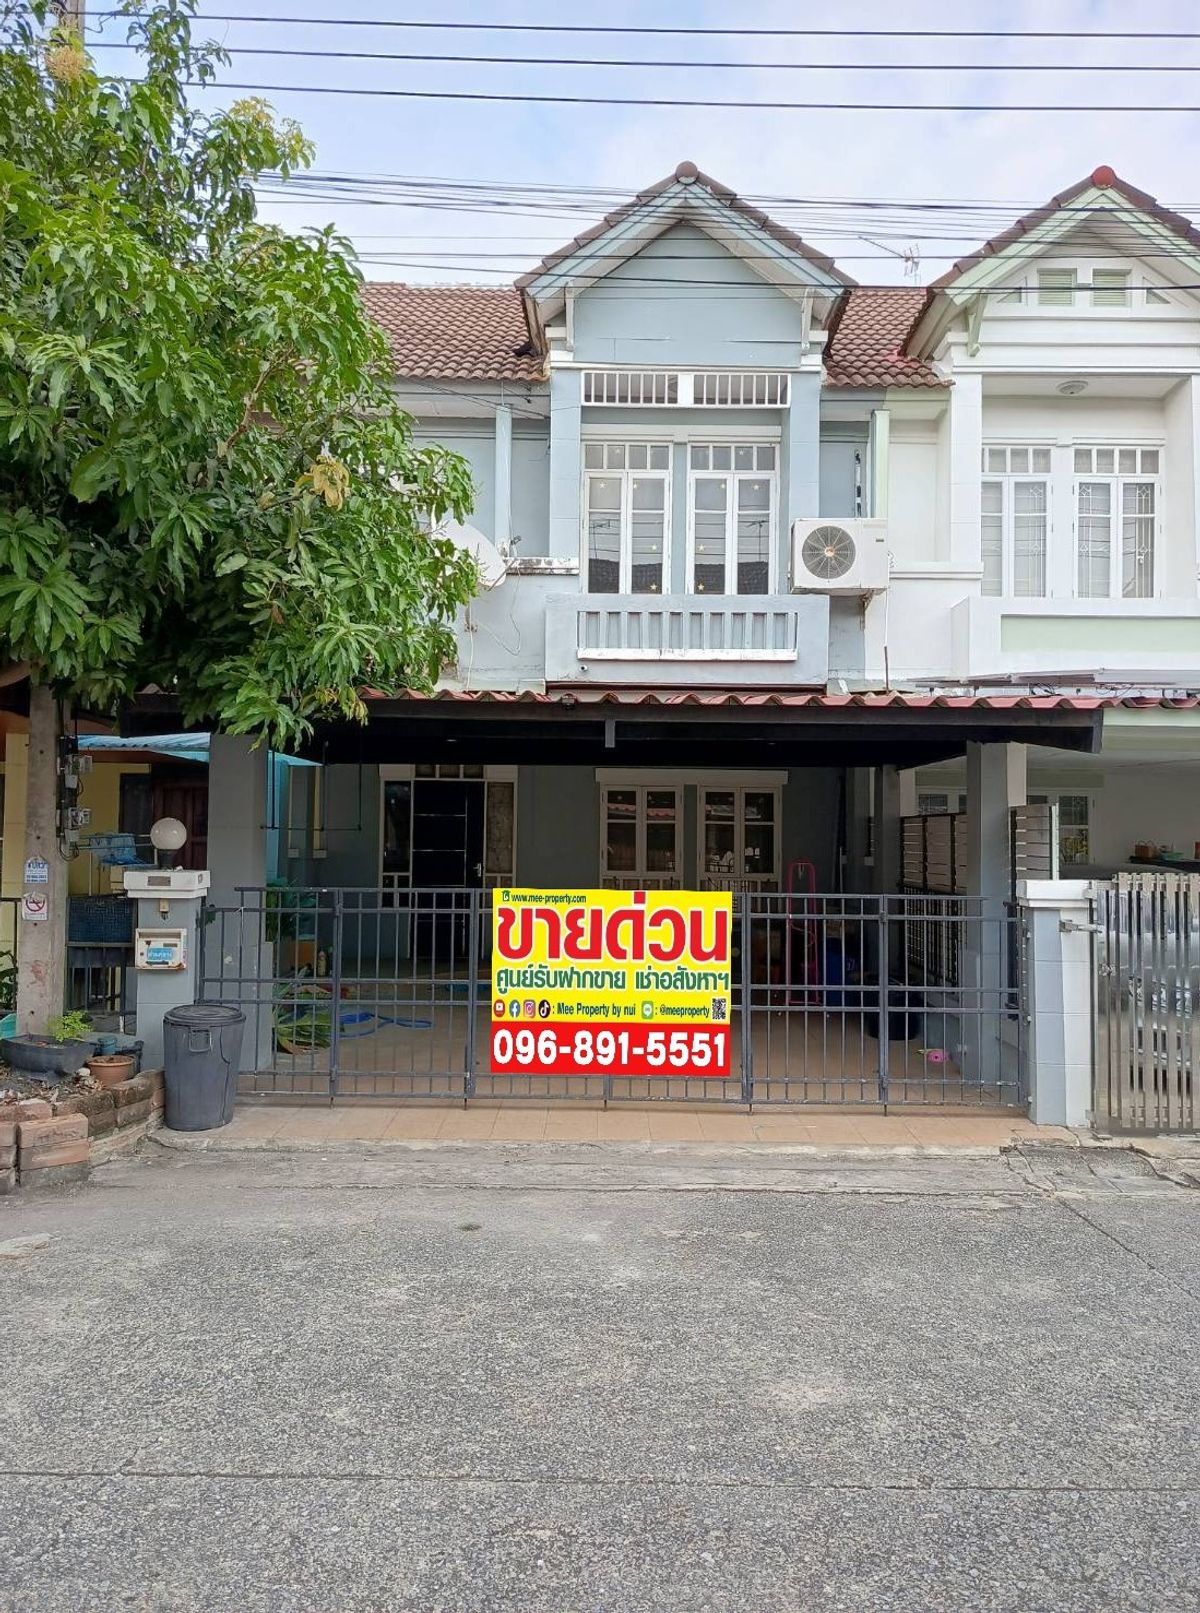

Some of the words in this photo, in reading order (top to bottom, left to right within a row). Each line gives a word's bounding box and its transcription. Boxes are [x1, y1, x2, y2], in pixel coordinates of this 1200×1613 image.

[511, 893, 587, 905] www.mee-property.com
[497, 891, 728, 962] ขายด่วน
[496, 963, 626, 994] ศูนย์รับฝากขาย
[635, 965, 730, 991] เช่าอสังหาฯ
[557, 1002, 575, 1015] Mee
[576, 1002, 610, 1017] Property
[612, 1003, 621, 1017] by
[624, 1004, 636, 1016] nui
[659, 1004, 710, 1018] @meeproperty
[493, 1028, 726, 1067] 096-891-5551
